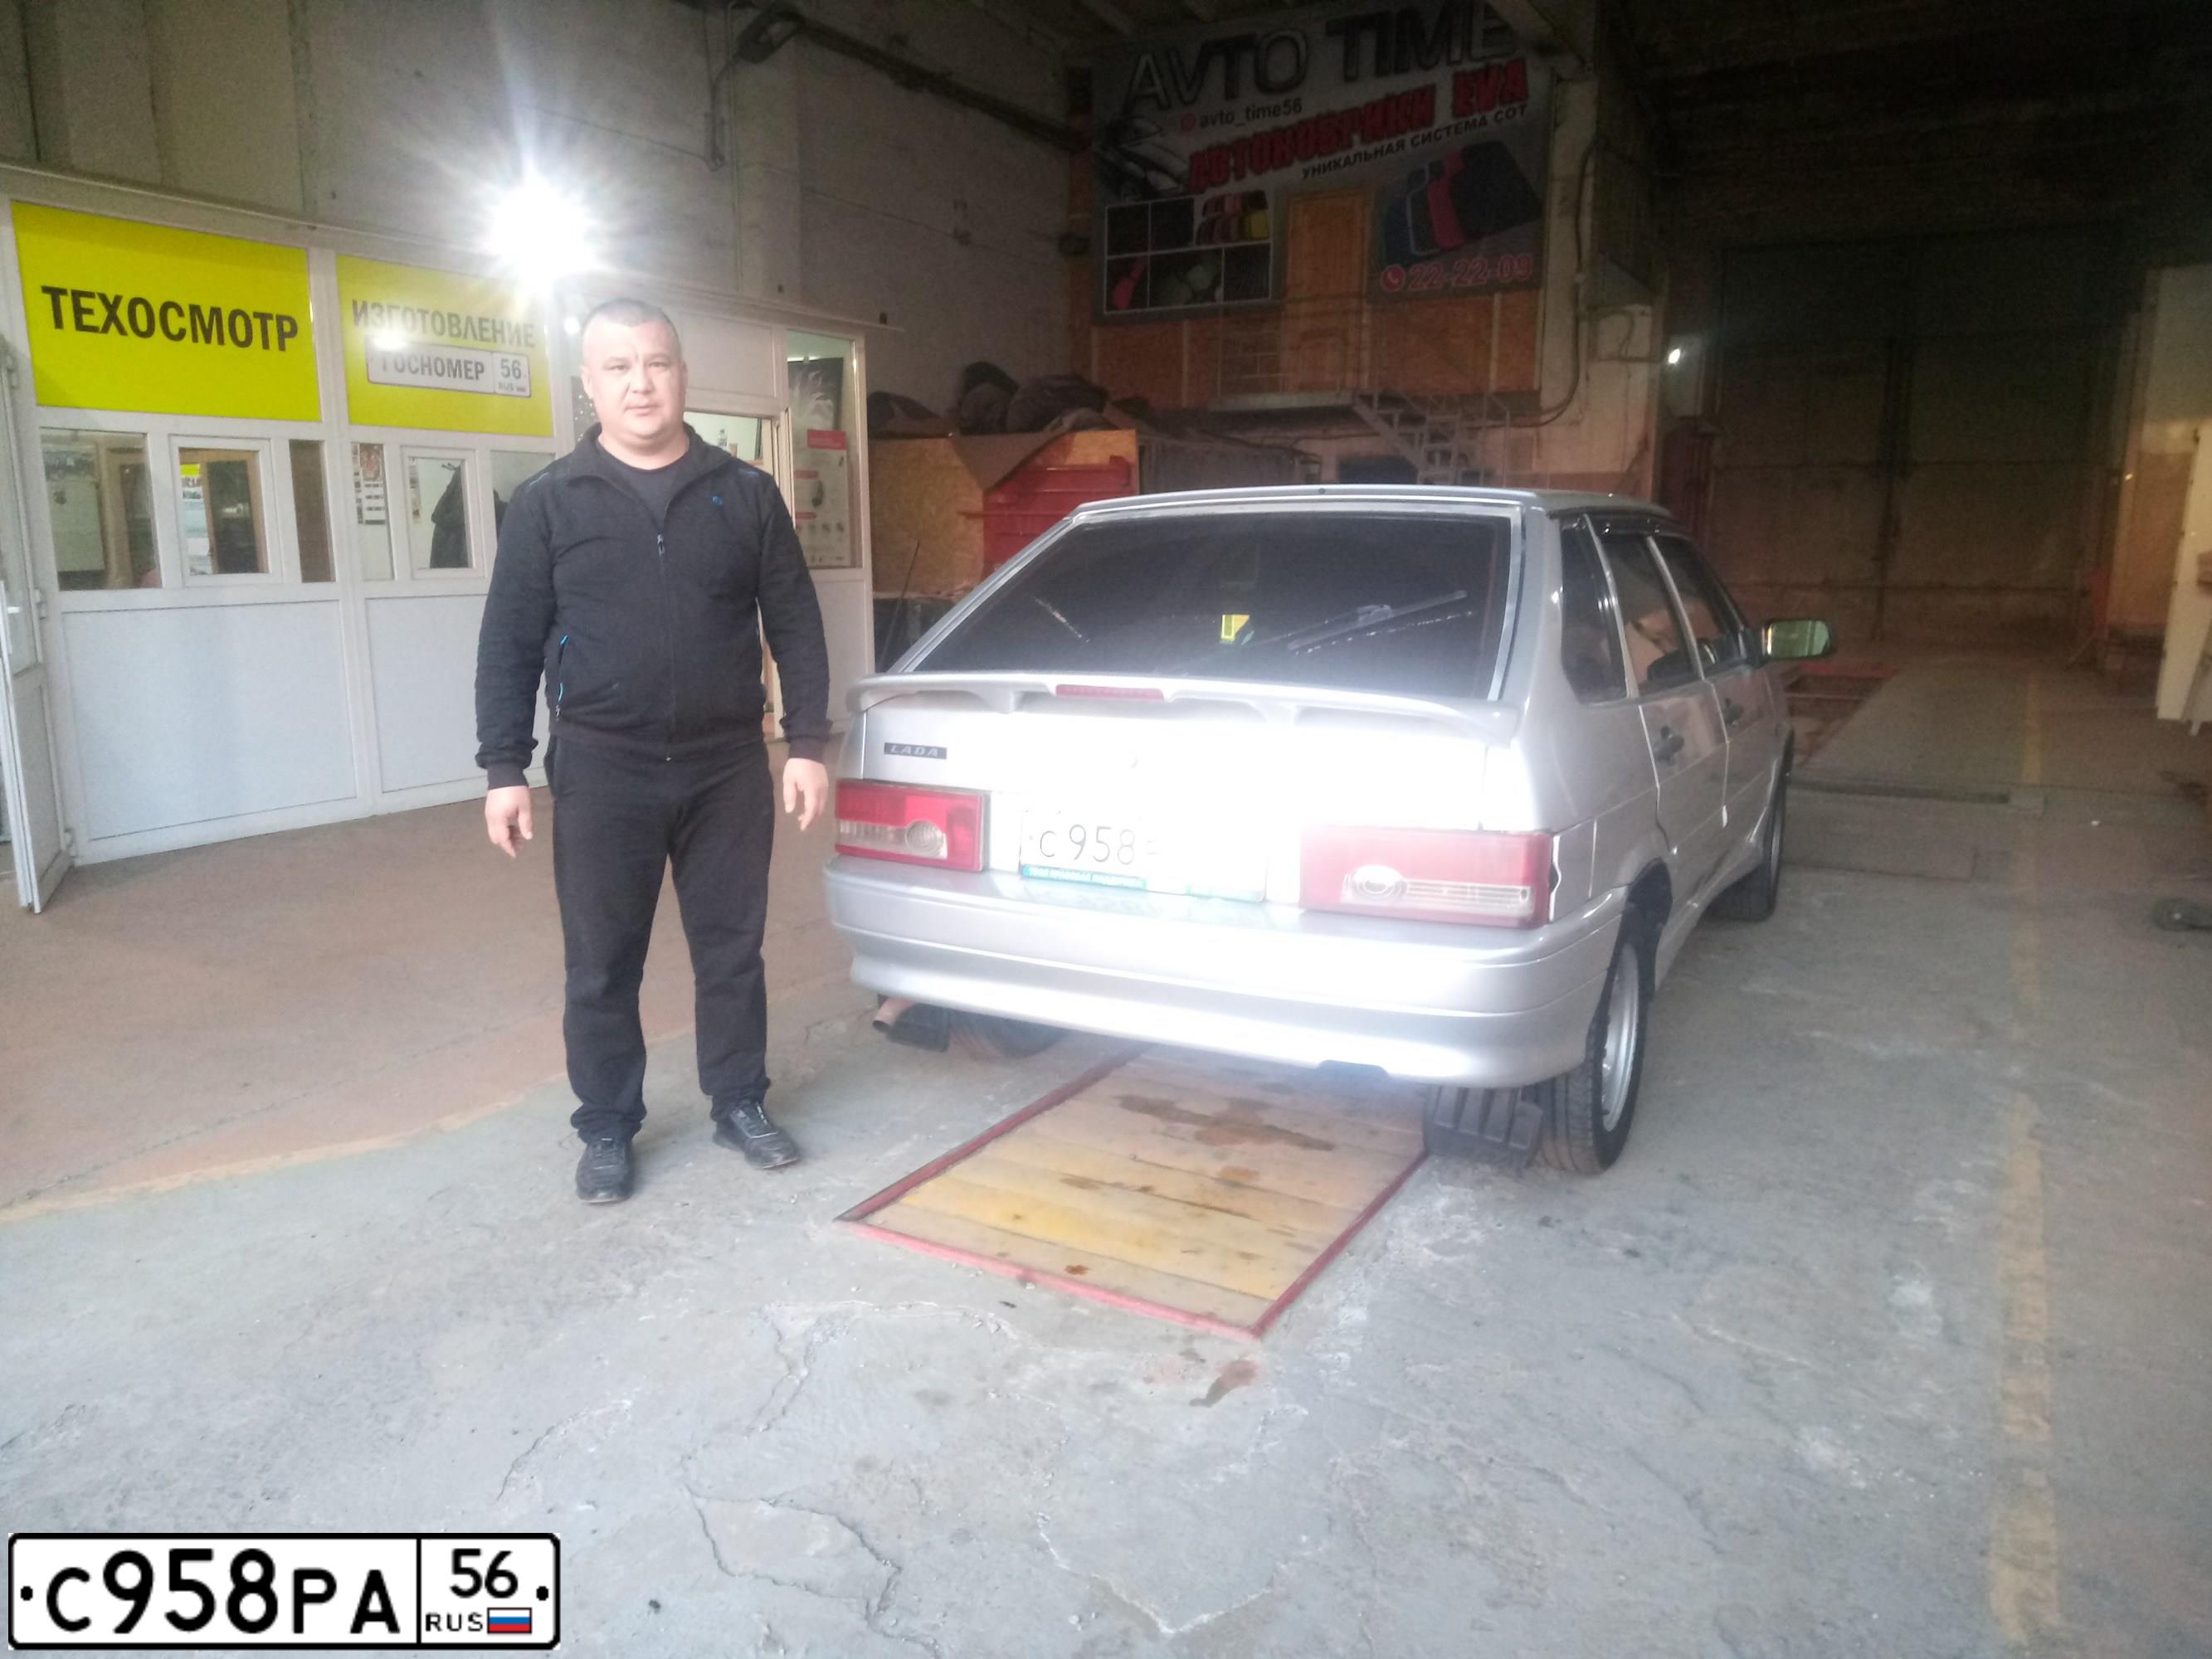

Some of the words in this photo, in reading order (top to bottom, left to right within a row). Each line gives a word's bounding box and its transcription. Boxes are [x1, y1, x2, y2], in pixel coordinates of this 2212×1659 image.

[1122, 28, 1309, 116] AVTO
[1326, 0, 1517, 82] TIME
[1200, 98, 1303, 129] avto_time56
[1302, 138, 1406, 179] УНИКАЛЬНАЯ
[1410, 116, 1488, 148] СИСТЕМА
[1493, 105, 1528, 124] СОТ
[41, 285, 299, 352] ТЕХОСМОТР
[352, 299, 537, 348] ИЗГОТОВЛЕНИЕ
[381, 349, 485, 381] ГОСНОМЕР
[499, 358, 523, 380] 56
[889, 744, 938, 757] LADA
